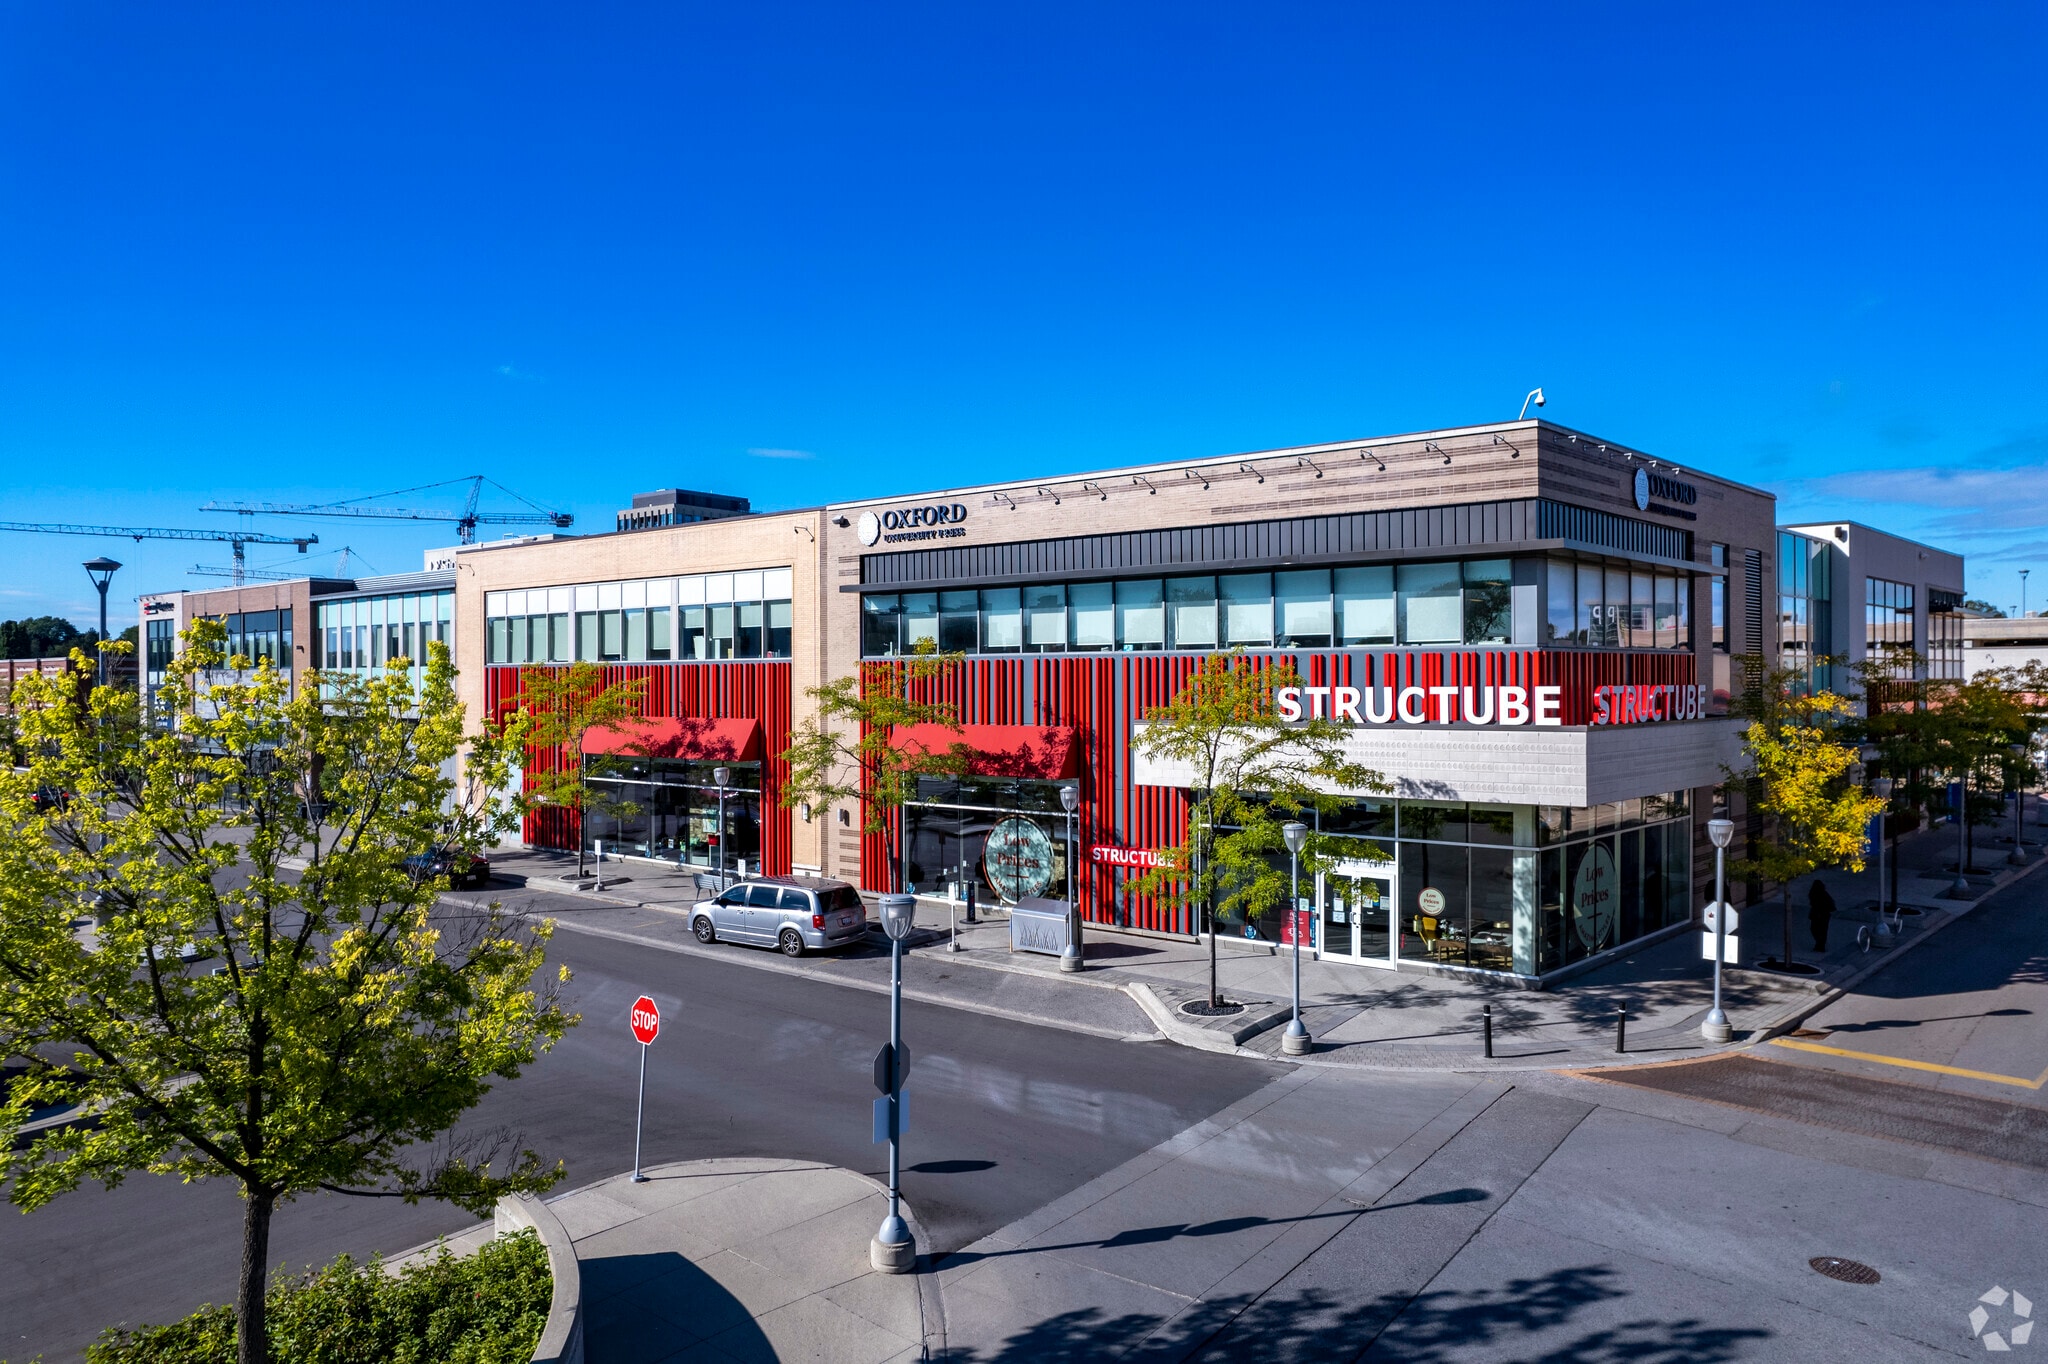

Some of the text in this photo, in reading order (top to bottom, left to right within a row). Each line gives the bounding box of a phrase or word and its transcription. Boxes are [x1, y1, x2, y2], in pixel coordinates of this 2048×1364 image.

[1651, 474, 1697, 506] OXFORD
[882, 503, 968, 530] OXFORD
[884, 527, 967, 544] UNIVERSITY PRESS
[1277, 685, 1562, 726] STRUCTUBE
[1593, 684, 1706, 725] STRUCTUBE
[633, 1009, 657, 1032] STOP
